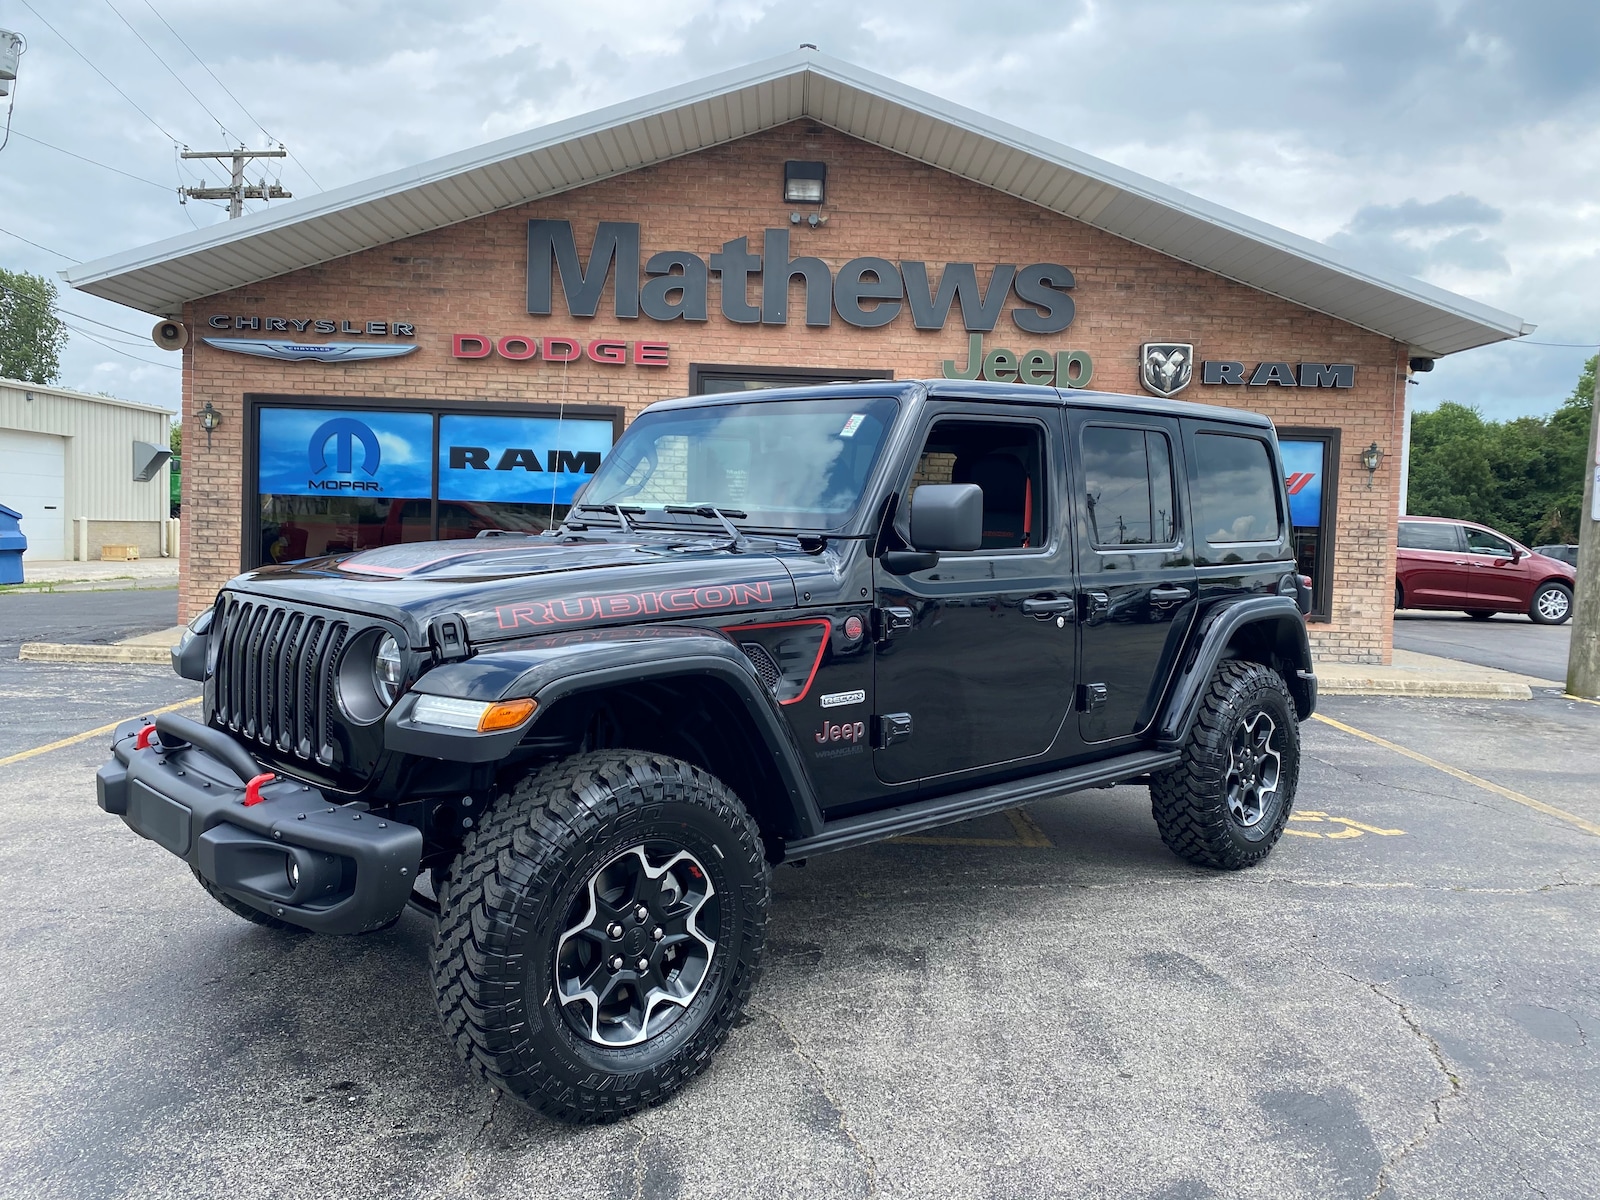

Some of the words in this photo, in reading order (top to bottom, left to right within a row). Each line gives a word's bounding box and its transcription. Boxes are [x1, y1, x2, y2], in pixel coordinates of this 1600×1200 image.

[526, 218, 1076, 334] Mathews
[208, 314, 415, 336] CHRYSLER
[452, 333, 670, 367] DODGE
[942, 333, 1093, 388] Jeep
[1203, 360, 1356, 388] RAM
[449, 446, 601, 474] RAM
[308, 480, 379, 492] MOPAR
[495, 581, 773, 629] RUBICON
[824, 693, 863, 705] RECON
[815, 720, 865, 744] Jeep
[815, 745, 864, 759] WRANGLER
